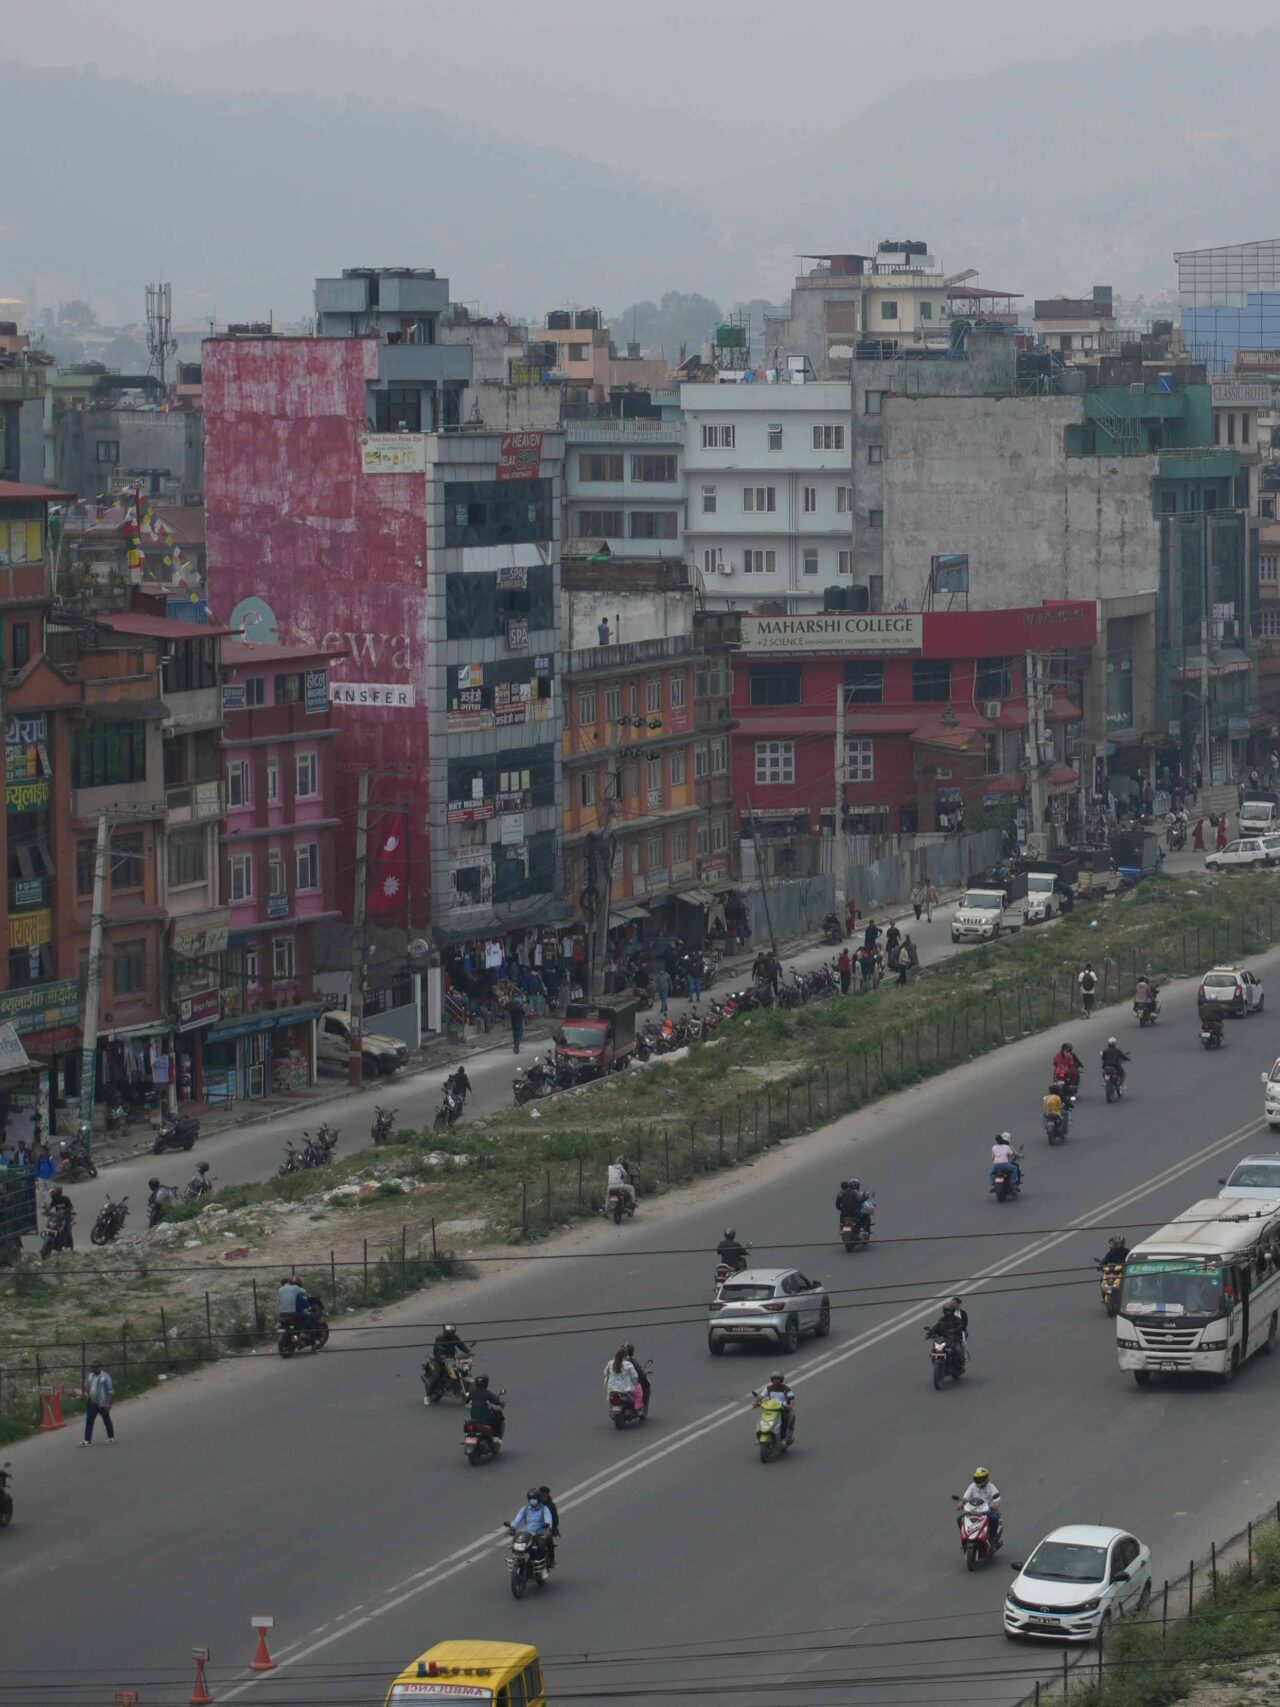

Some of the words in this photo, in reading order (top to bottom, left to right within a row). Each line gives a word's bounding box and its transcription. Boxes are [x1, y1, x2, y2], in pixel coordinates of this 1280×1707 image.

[1213, 386, 1244, 400] CLASSIC
[1245, 386, 1269, 400] HOTEL
[511, 433, 541, 448] HEAVEN
[516, 448, 540, 470] SPA
[510, 568, 524, 579] SPA
[758, 619, 841, 634] MAHARSHI
[846, 618, 913, 632] COLLEGE
[510, 629, 528, 645] SPA
[758, 639, 768, 647] +2
[769, 638, 804, 647] SCIENCE
